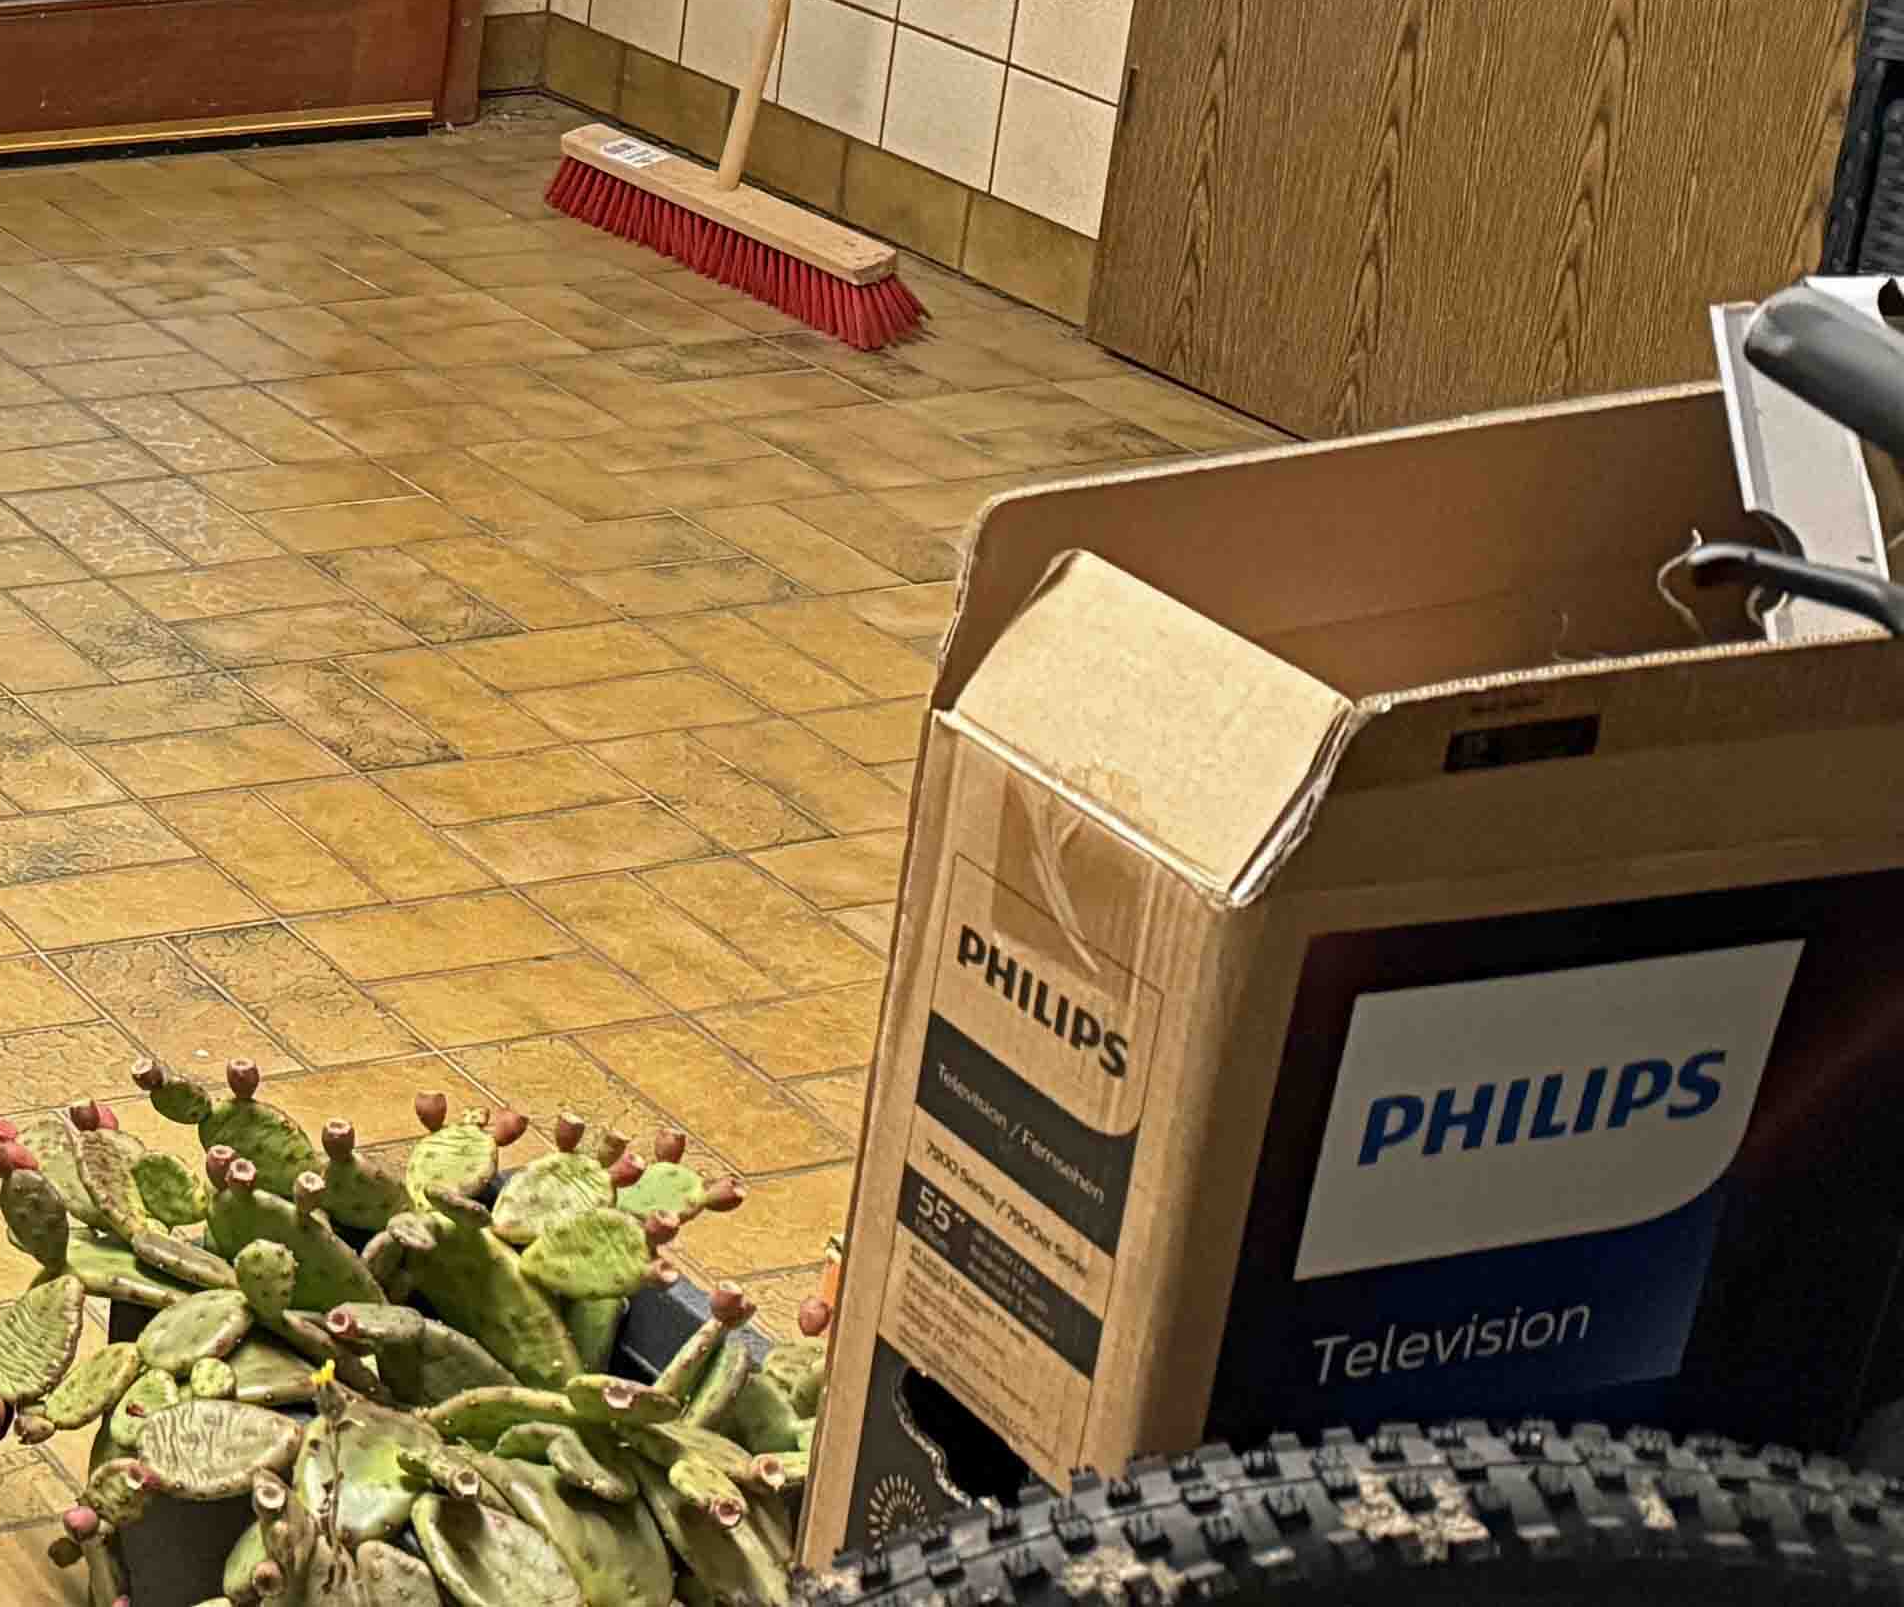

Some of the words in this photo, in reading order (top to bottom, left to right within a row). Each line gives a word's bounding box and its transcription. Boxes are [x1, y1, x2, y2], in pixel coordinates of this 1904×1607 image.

[956, 923, 1129, 1079] PHILIPS
[1357, 1049, 1726, 1167] PHILIPS
[1312, 1301, 1591, 1385] Television
